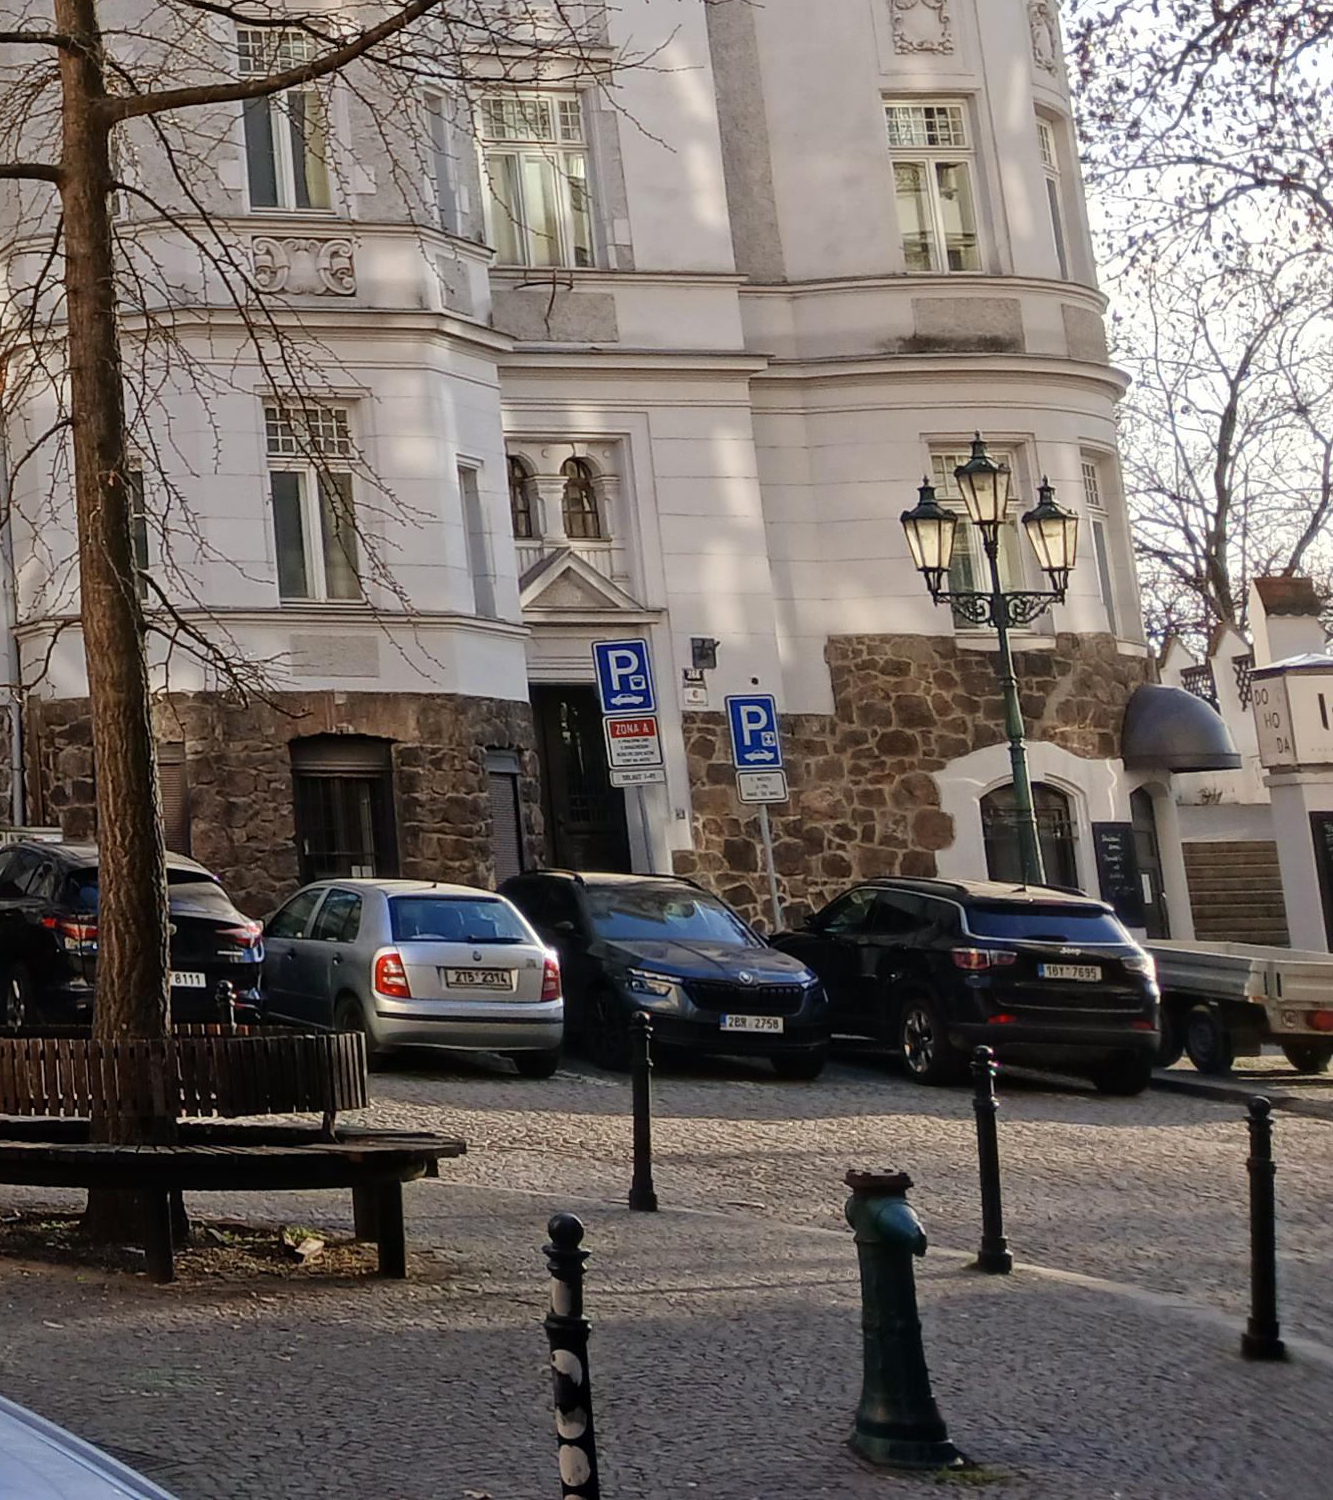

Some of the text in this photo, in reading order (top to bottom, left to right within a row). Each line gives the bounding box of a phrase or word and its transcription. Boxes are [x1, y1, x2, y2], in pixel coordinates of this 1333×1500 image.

[607, 649, 639, 691] P
[1254, 688, 1269, 706] DO
[739, 704, 768, 746] P
[1264, 712, 1280, 729] HO
[1276, 737, 1291, 754] DA
[174, 973, 201, 985] 8111
